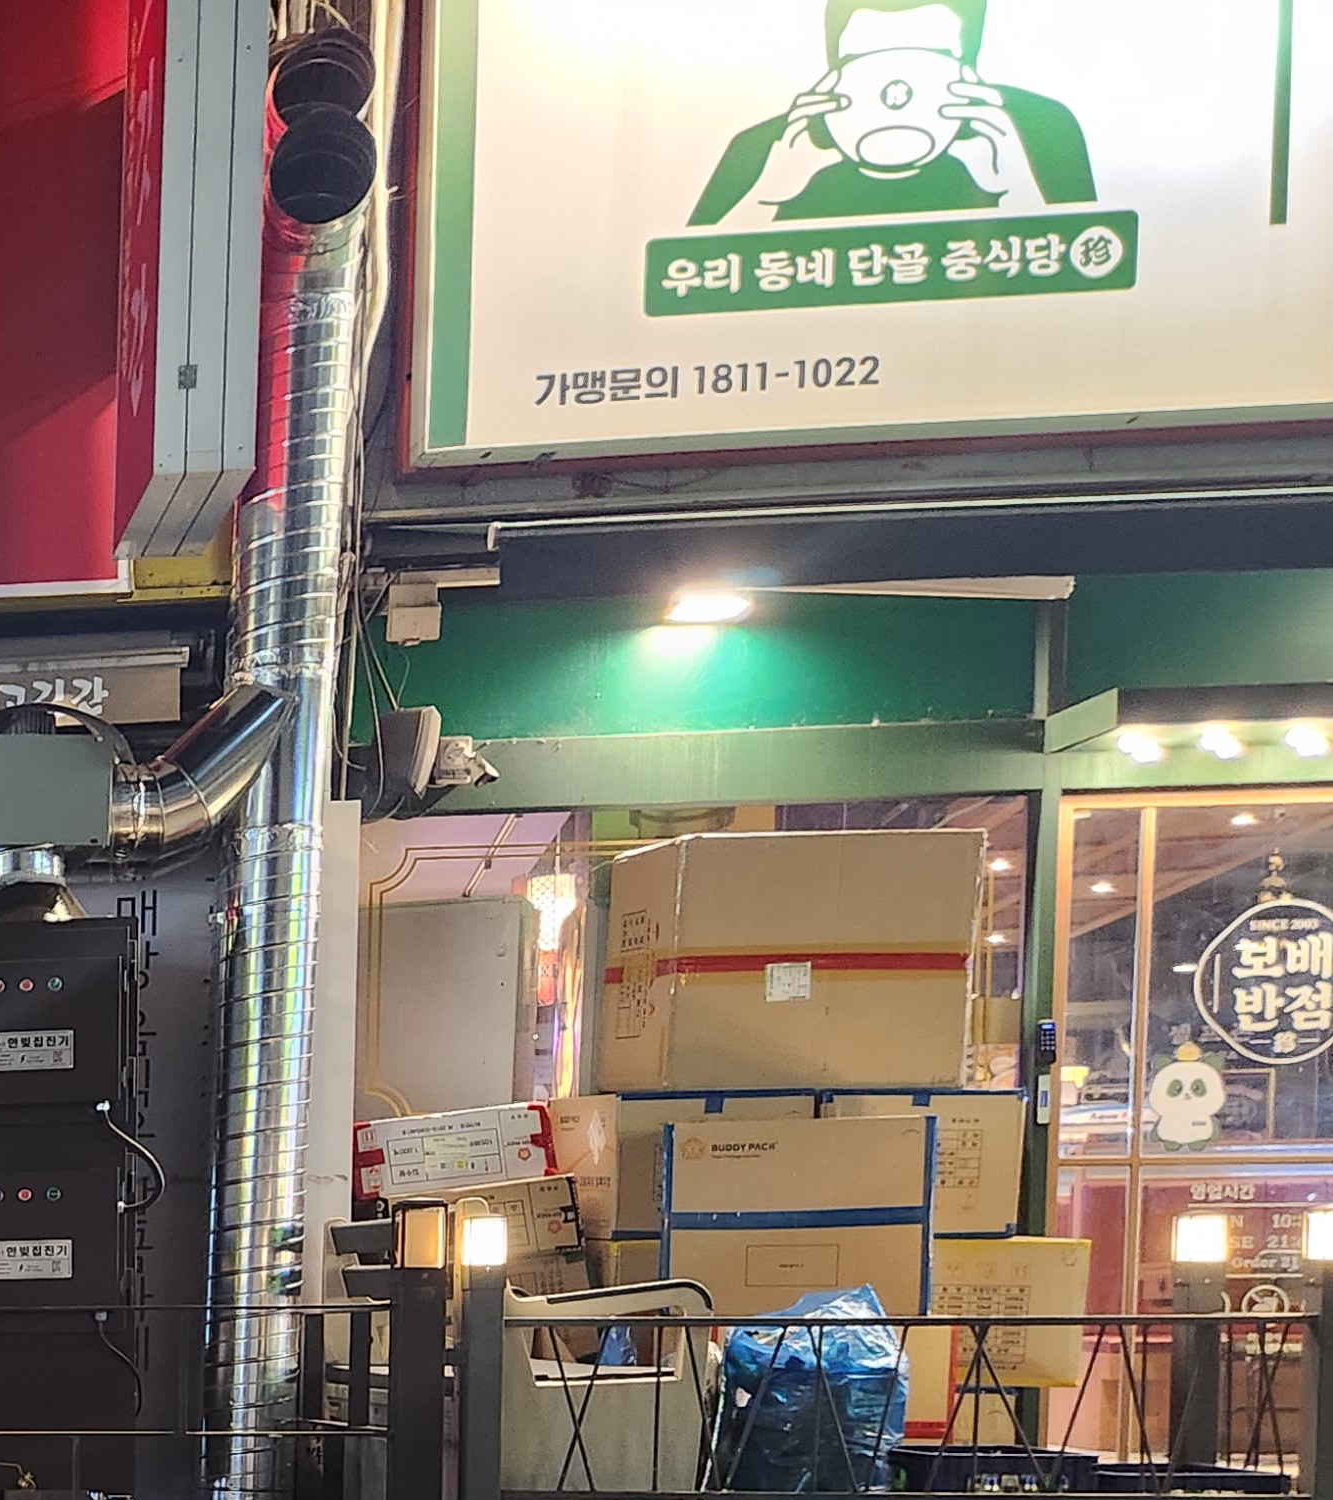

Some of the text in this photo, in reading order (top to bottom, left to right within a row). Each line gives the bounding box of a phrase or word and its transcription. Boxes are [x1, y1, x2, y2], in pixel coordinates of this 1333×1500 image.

[660, 252, 743, 298] 우리
[753, 247, 836, 292] 동네
[847, 242, 930, 287] 단골
[940, 233, 1065, 282] 중식당
[534, 354, 881, 406] 가맹문의 1811-1022
[1248, 918, 1289, 932] SINCE
[1231, 931, 1333, 980] 보배
[1233, 980, 1333, 1033] 반점
[711, 1142, 747, 1153] BUDDY
[1190, 1183, 1256, 1201] 영업시간
